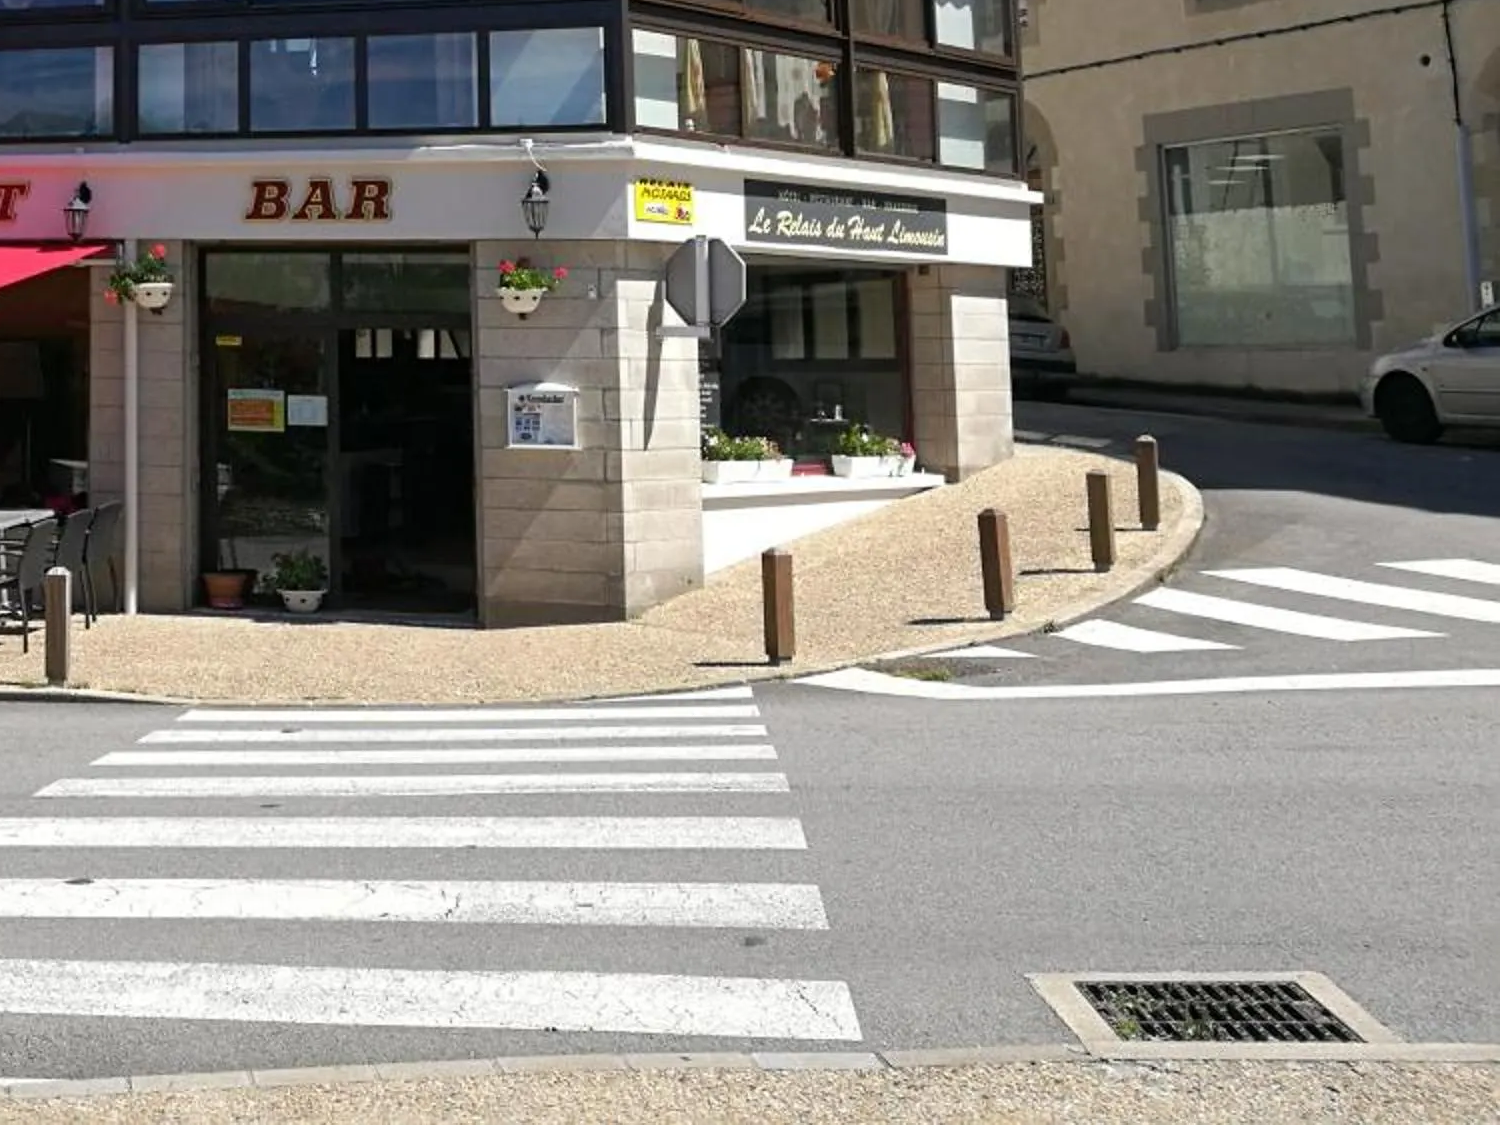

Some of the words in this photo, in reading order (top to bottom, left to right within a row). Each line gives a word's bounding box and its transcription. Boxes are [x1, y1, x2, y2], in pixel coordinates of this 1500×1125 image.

[244, 179, 394, 223] BAR
[748, 207, 771, 235] Le
[775, 210, 822, 237] Relais
[826, 216, 845, 239] du
[847, 215, 885, 242] Haut
[887, 220, 945, 247] Limousin
